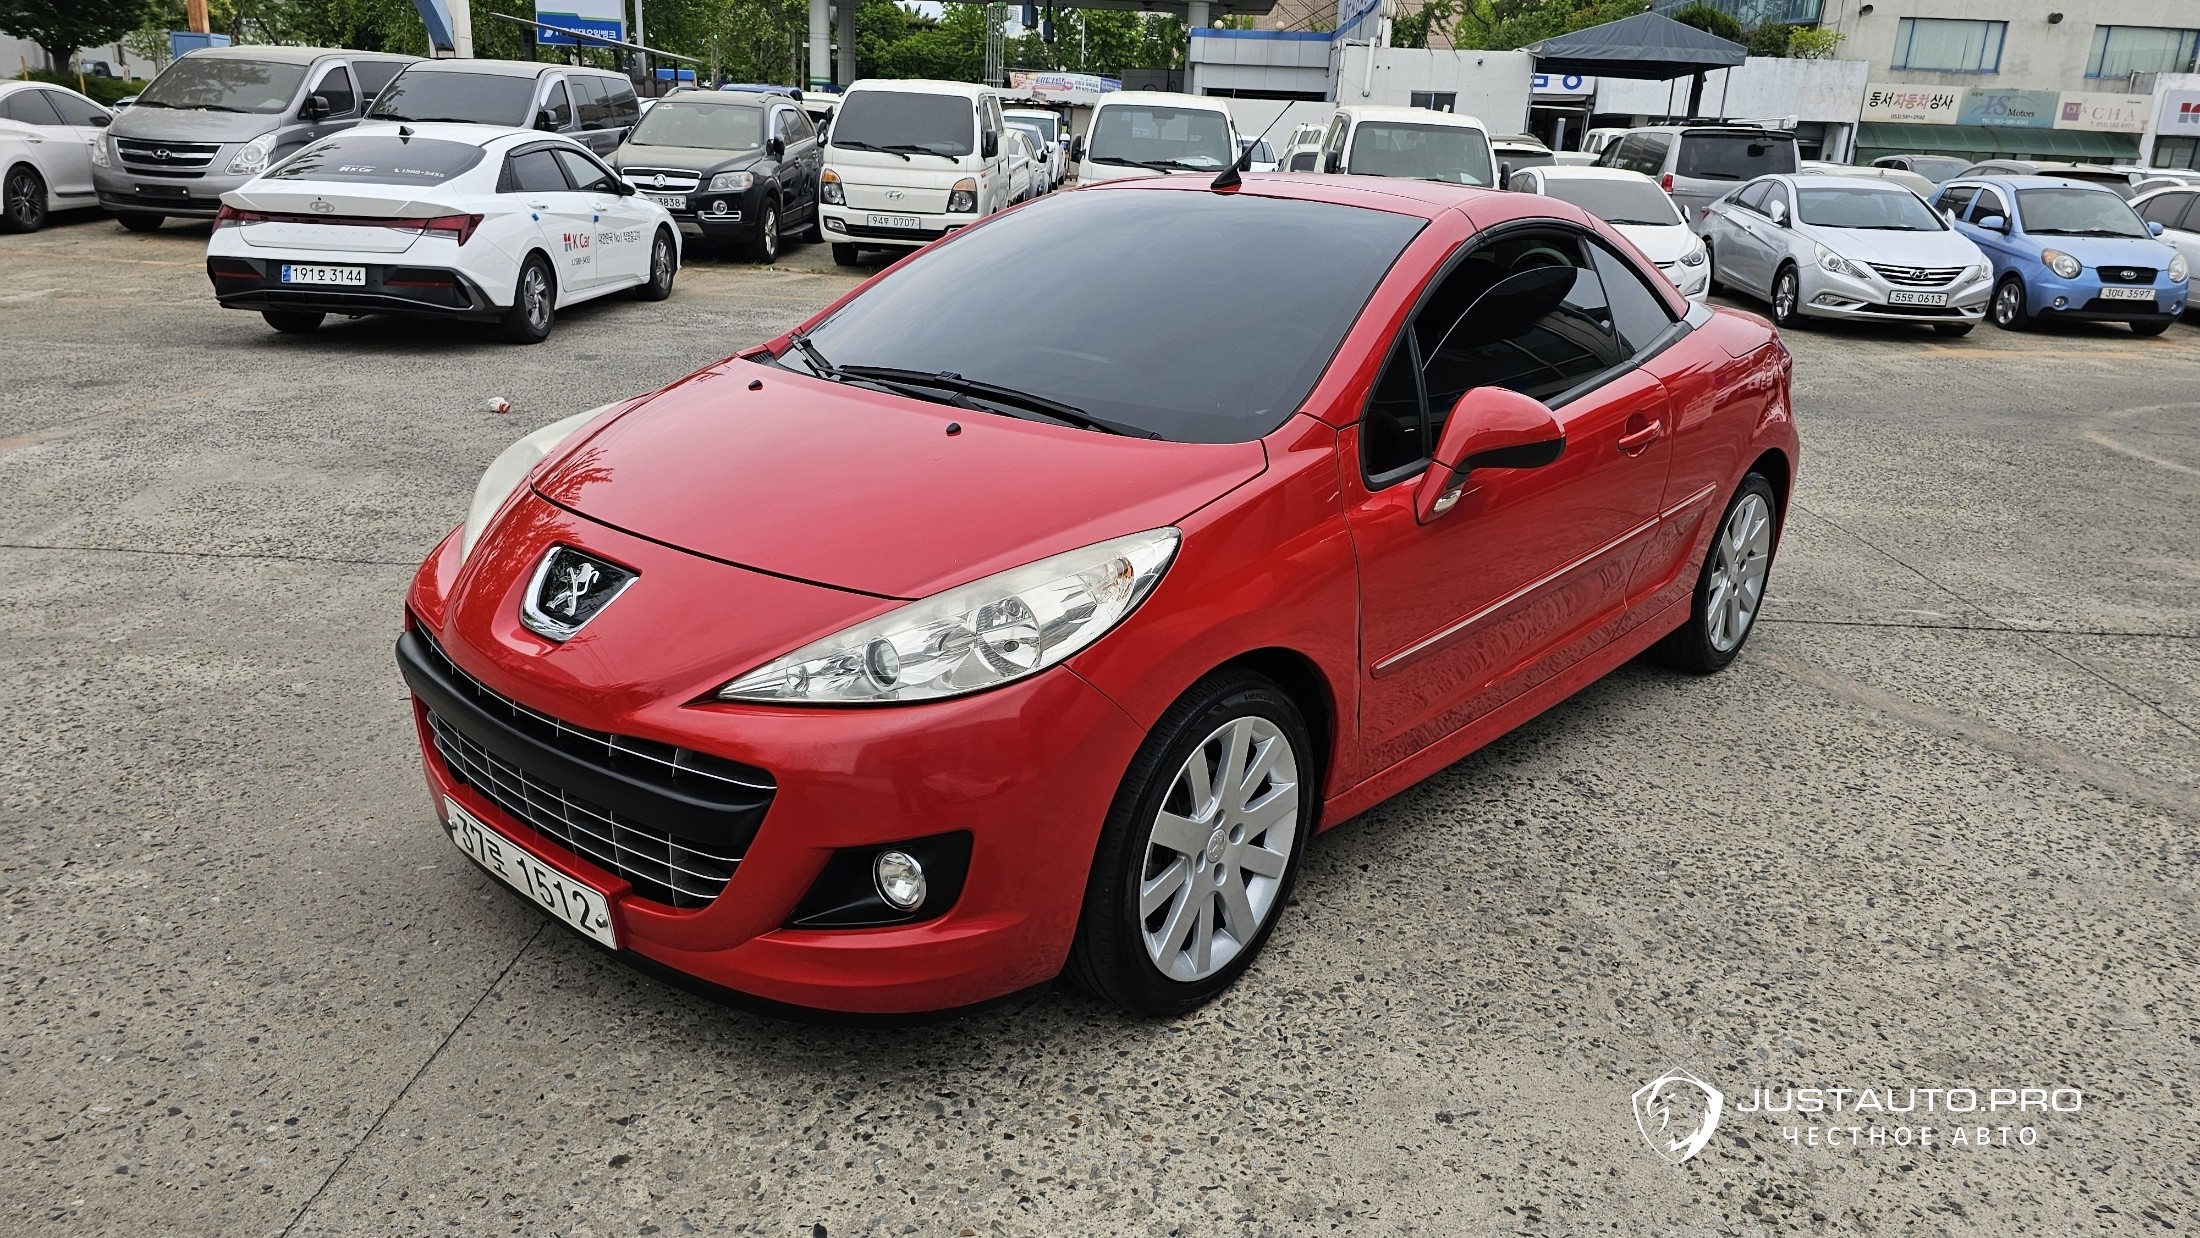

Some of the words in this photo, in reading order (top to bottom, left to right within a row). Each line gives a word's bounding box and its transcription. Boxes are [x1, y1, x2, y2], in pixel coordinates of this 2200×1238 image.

[2007, 108, 2035, 118] Motors
[893, 217, 916, 228] 0707
[572, 233, 579, 250] K
[579, 233, 591, 248] Car
[293, 267, 326, 281] 191호
[329, 268, 362, 283] 3144
[1917, 293, 1942, 304] 0613
[2126, 289, 2151, 299] 3597
[456, 813, 510, 878] 37로
[516, 857, 597, 934] 1512
